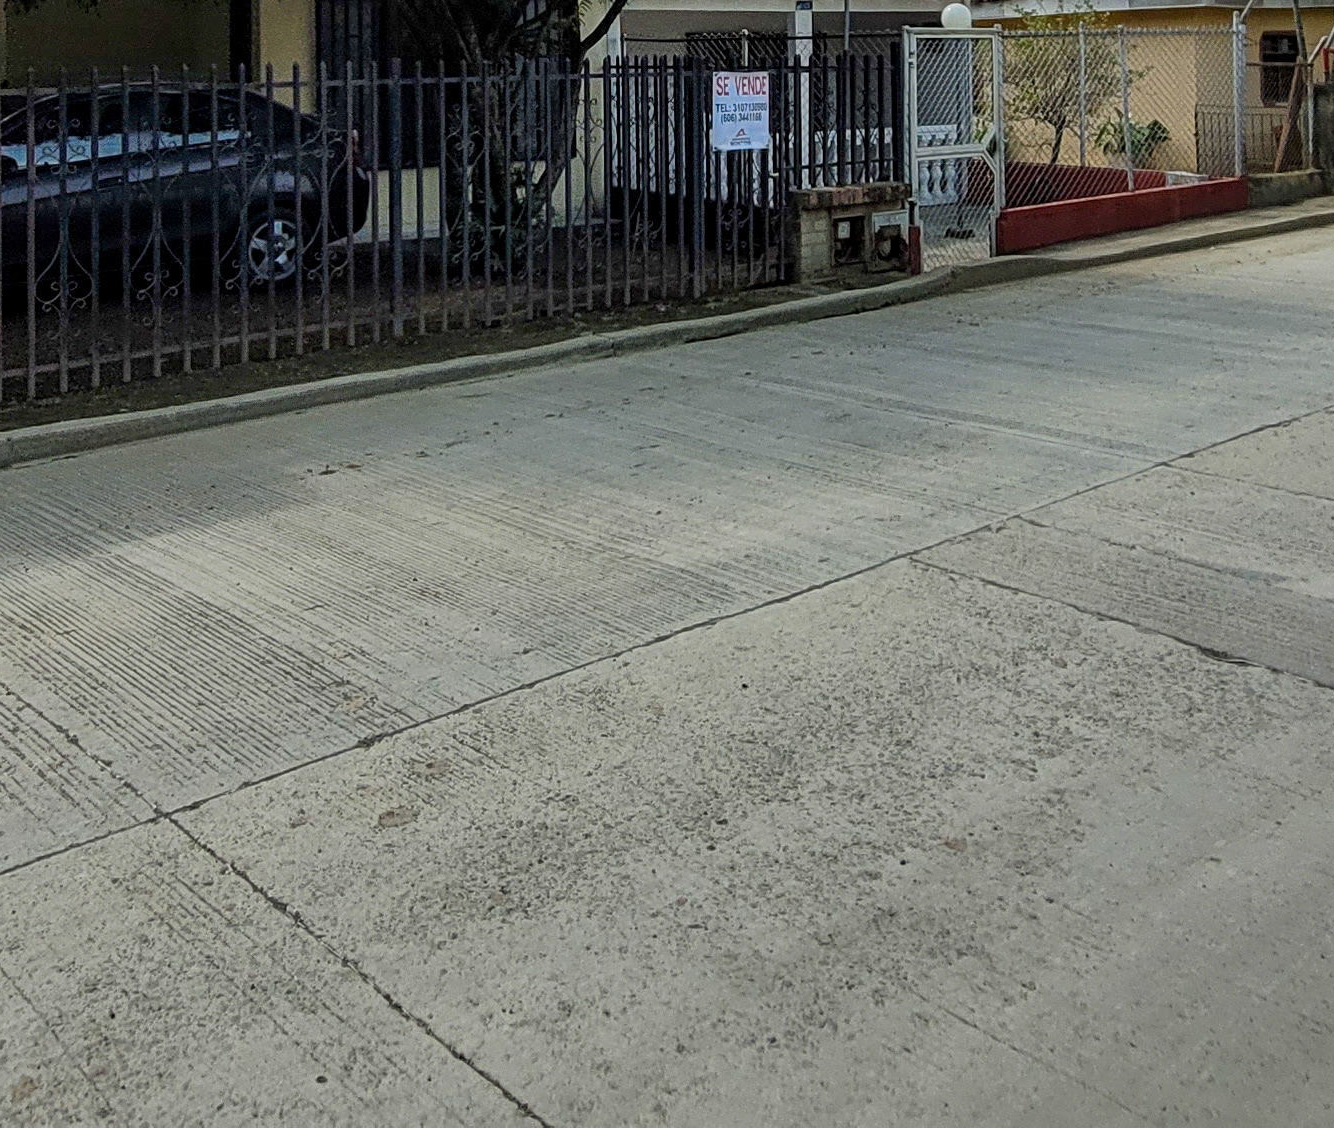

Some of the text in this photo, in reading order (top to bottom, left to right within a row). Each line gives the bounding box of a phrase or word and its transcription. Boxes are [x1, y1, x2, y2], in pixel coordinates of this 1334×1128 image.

[716, 75, 767, 96] SE VENDE
[715, 103, 732, 113] TEL:
